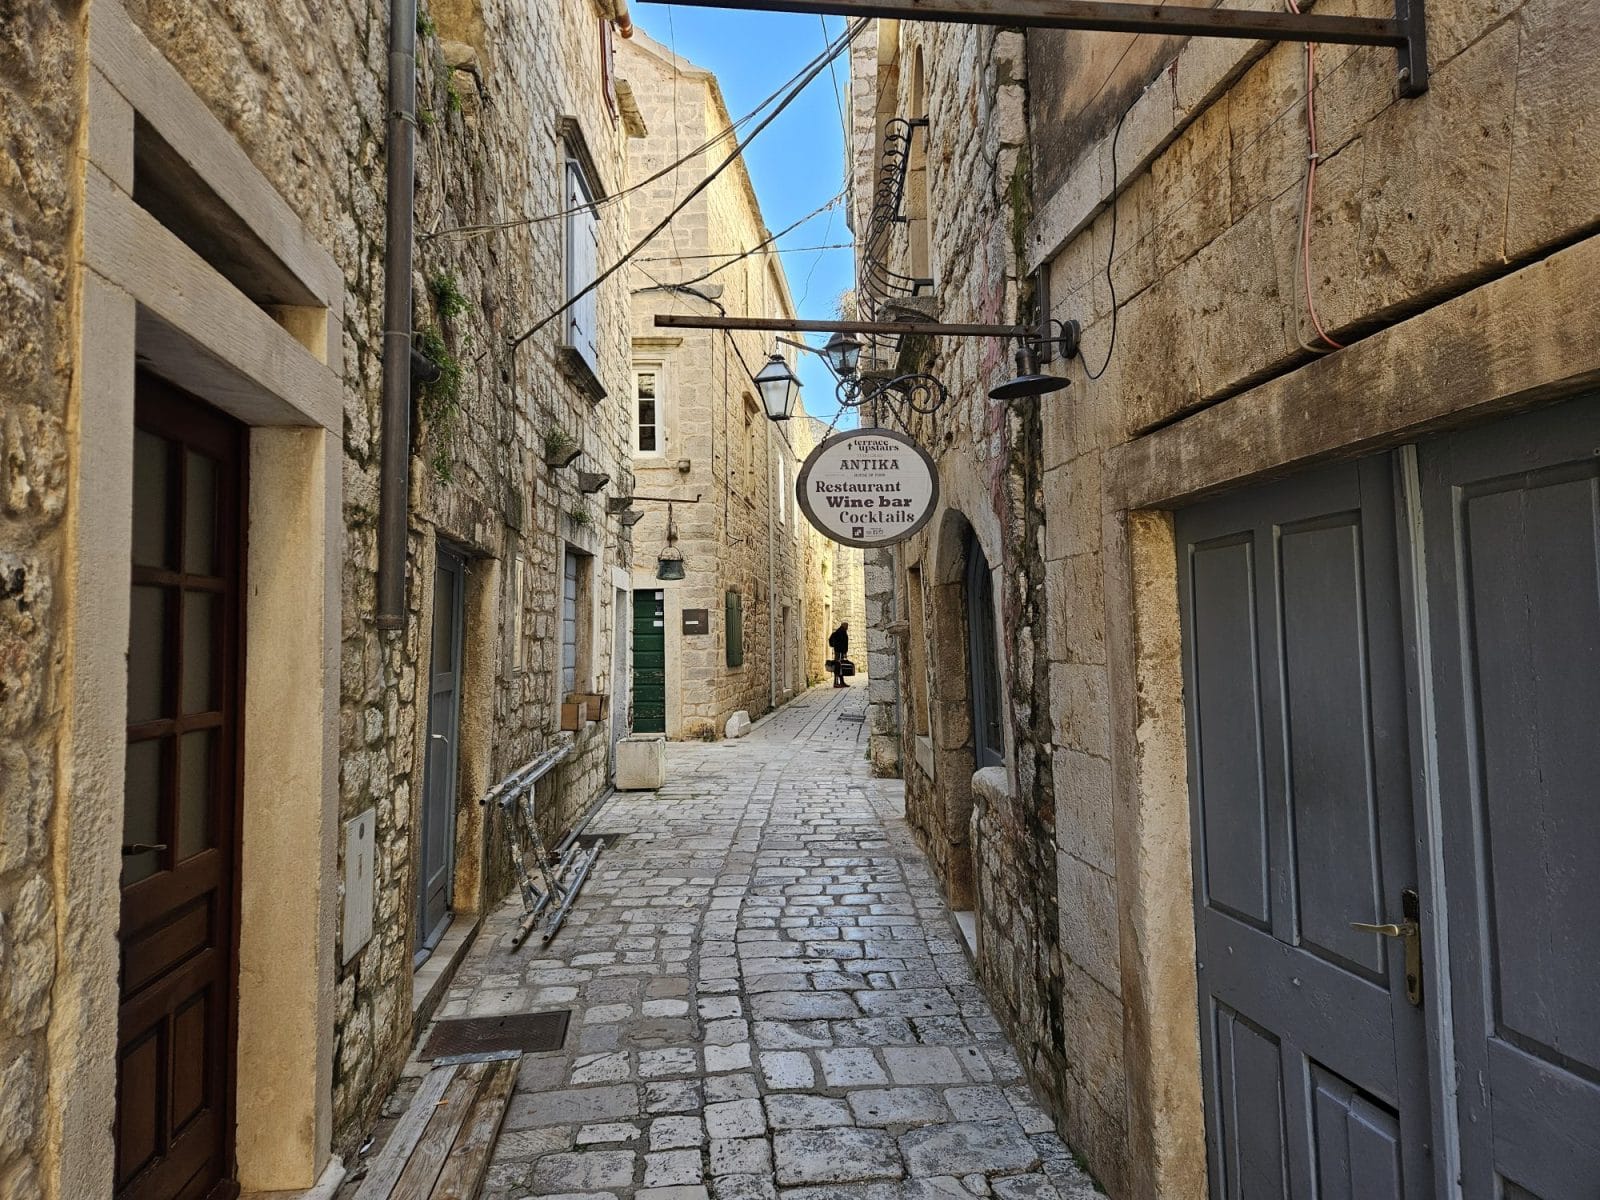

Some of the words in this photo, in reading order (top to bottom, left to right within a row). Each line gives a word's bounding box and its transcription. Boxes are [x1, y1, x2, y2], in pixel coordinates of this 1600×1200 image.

[859, 445, 899, 453] upstairs
[840, 459, 900, 471] ANTIKA
[816, 481, 901, 493] Restaurant
[826, 496, 874, 508] Wine
[879, 496, 912, 508] bar
[840, 511, 915, 524] Cocktails
